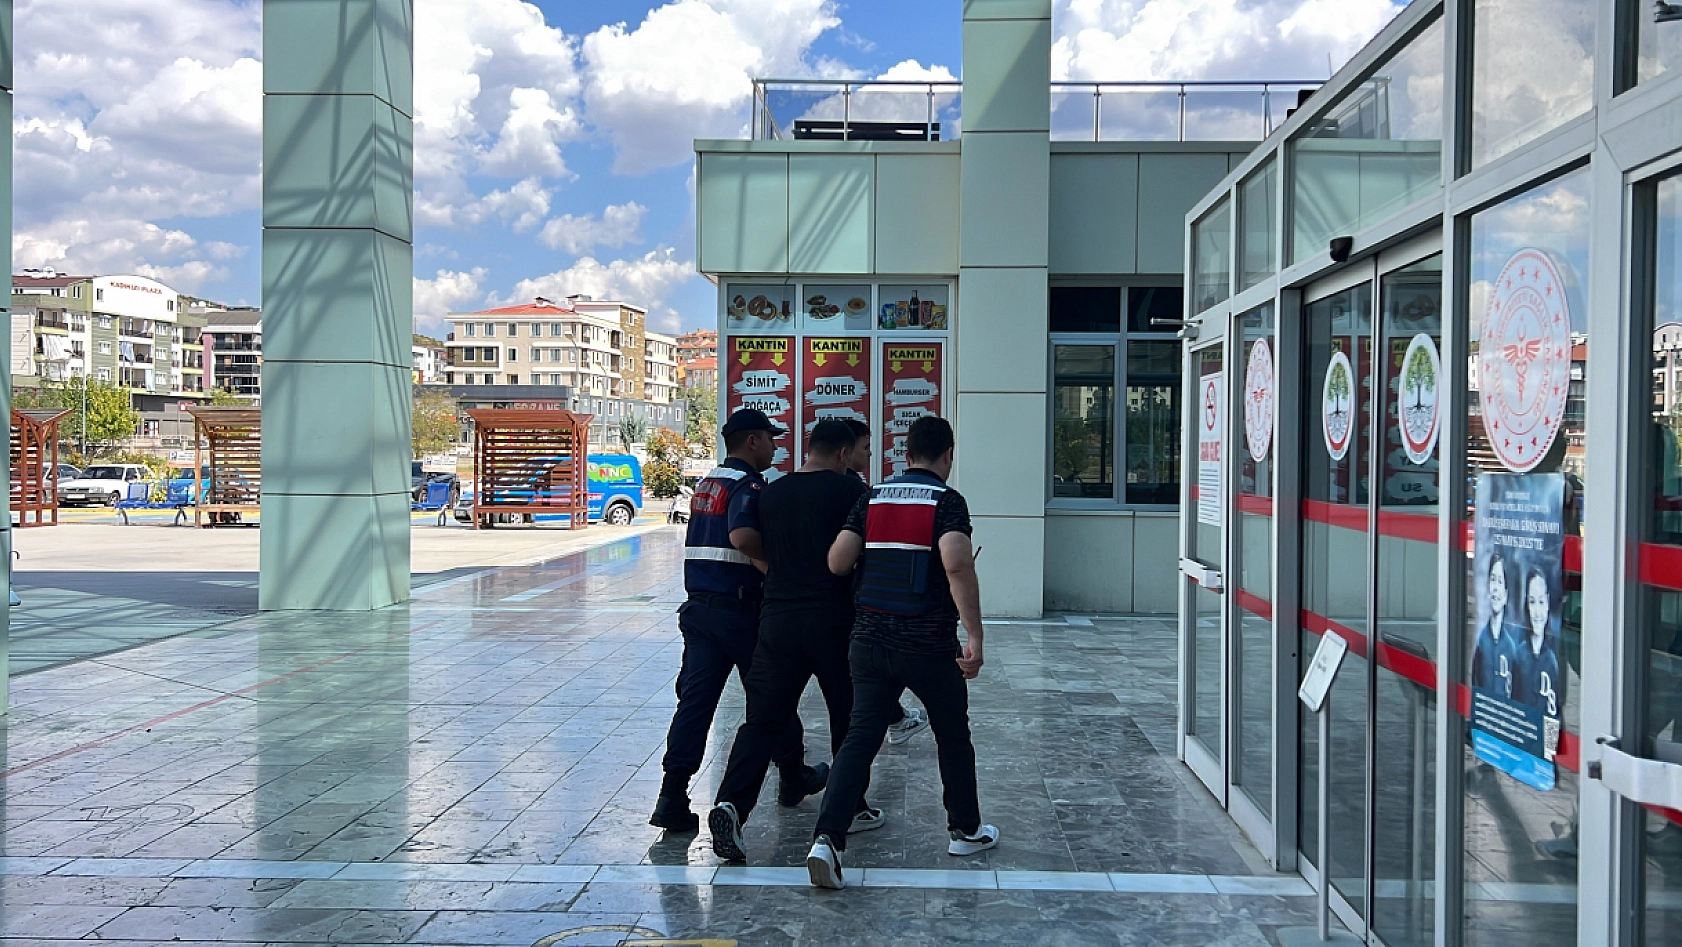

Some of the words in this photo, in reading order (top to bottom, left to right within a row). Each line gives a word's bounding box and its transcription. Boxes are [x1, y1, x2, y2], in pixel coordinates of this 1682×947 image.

[745, 375, 777, 388] SİMİT
[817, 381, 856, 396] DÖNER
[744, 399, 781, 414] POĞAÇA
